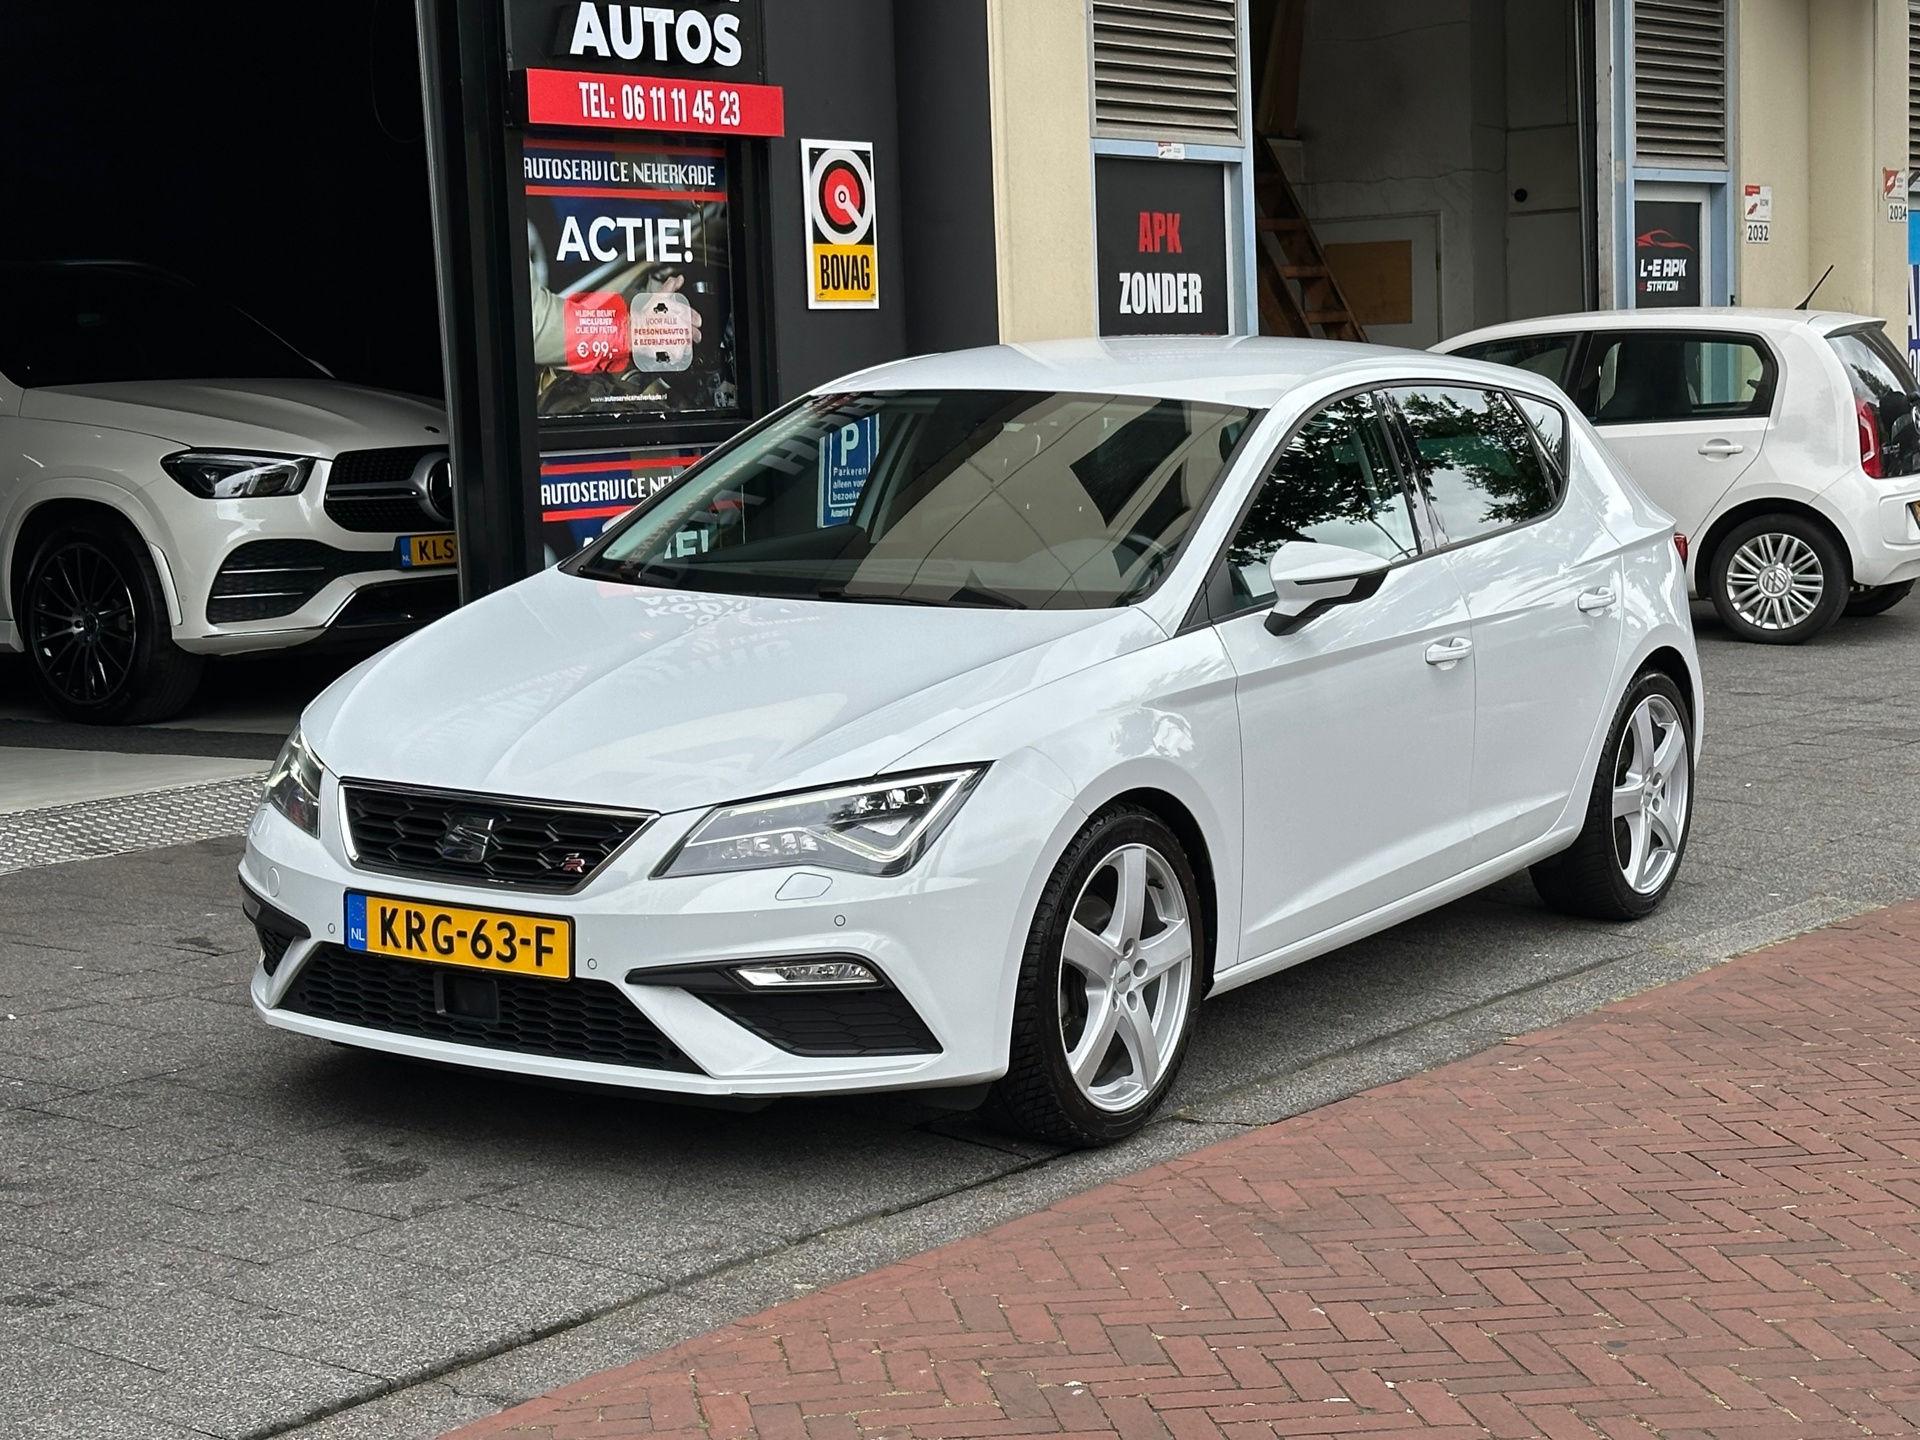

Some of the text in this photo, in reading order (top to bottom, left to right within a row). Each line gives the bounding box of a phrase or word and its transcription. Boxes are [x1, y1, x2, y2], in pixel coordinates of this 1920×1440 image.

[570, 1, 743, 67] AUTOS
[579, 81, 741, 127] TEL: 06 11 11 45 23
[523, 156, 716, 187] AUTOSERVICE NEHERKADE
[1889, 205, 1907, 221] 2034
[556, 215, 694, 264] ACTIE!
[1138, 212, 1183, 254] APK
[1747, 224, 1769, 242] 2032
[820, 254, 871, 291] BOVAG
[1640, 258, 1687, 278] L-E APK
[1119, 271, 1203, 315] ZONDER
[1646, 280, 1679, 292] STATION
[645, 318, 662, 326] VOOR
[592, 341, 619, 360] 99,-
[841, 422, 860, 467] P
[832, 466, 867, 477] Parkeren
[832, 479, 852, 489] alleen
[541, 476, 646, 506] AUTOSERVICE
[349, 927, 367, 942] NL
[379, 905, 556, 968] KRG-63-F
